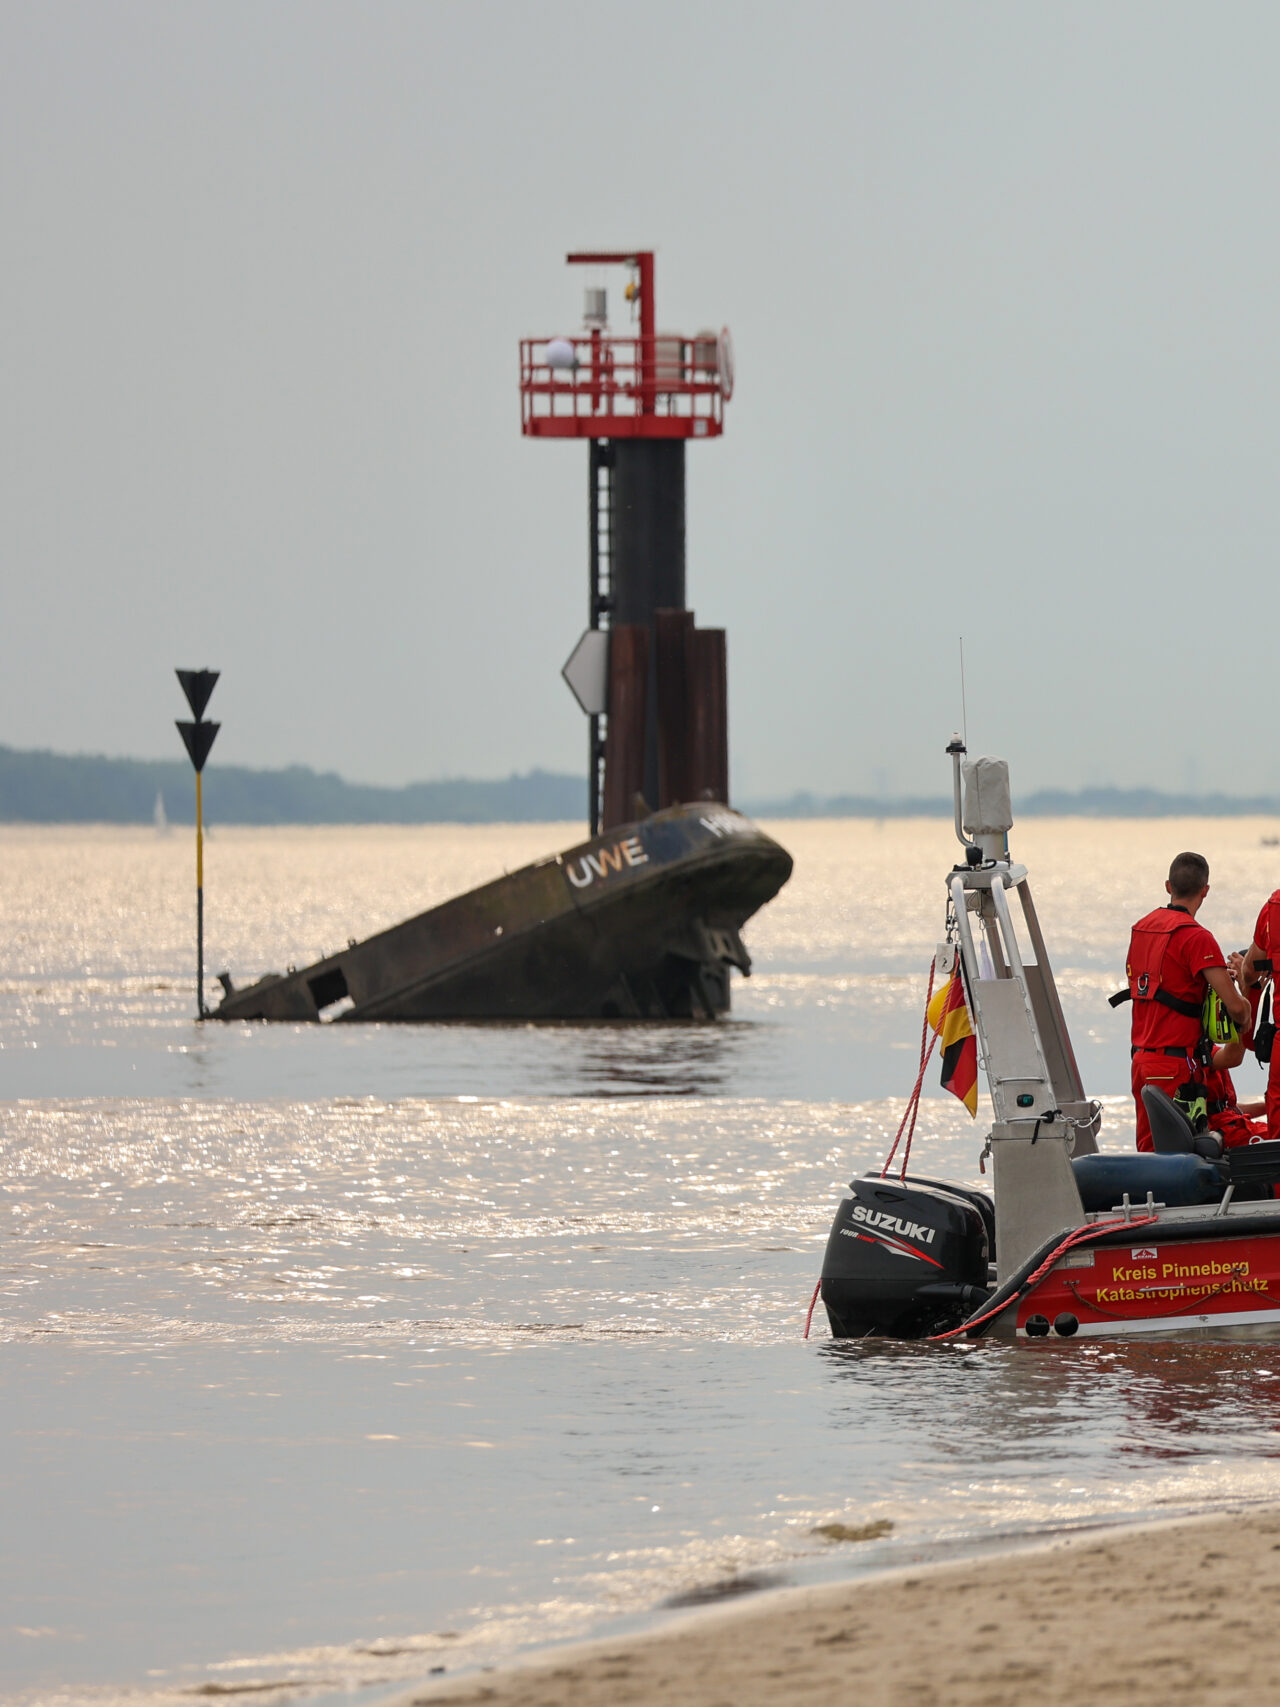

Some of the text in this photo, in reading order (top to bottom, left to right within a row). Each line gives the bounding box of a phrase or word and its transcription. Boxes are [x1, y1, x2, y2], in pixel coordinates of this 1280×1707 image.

[566, 836, 649, 888] UWE
[851, 1205, 936, 1244] SUZUKI
[1112, 1260, 1249, 1282] Kreis Pinneberg
